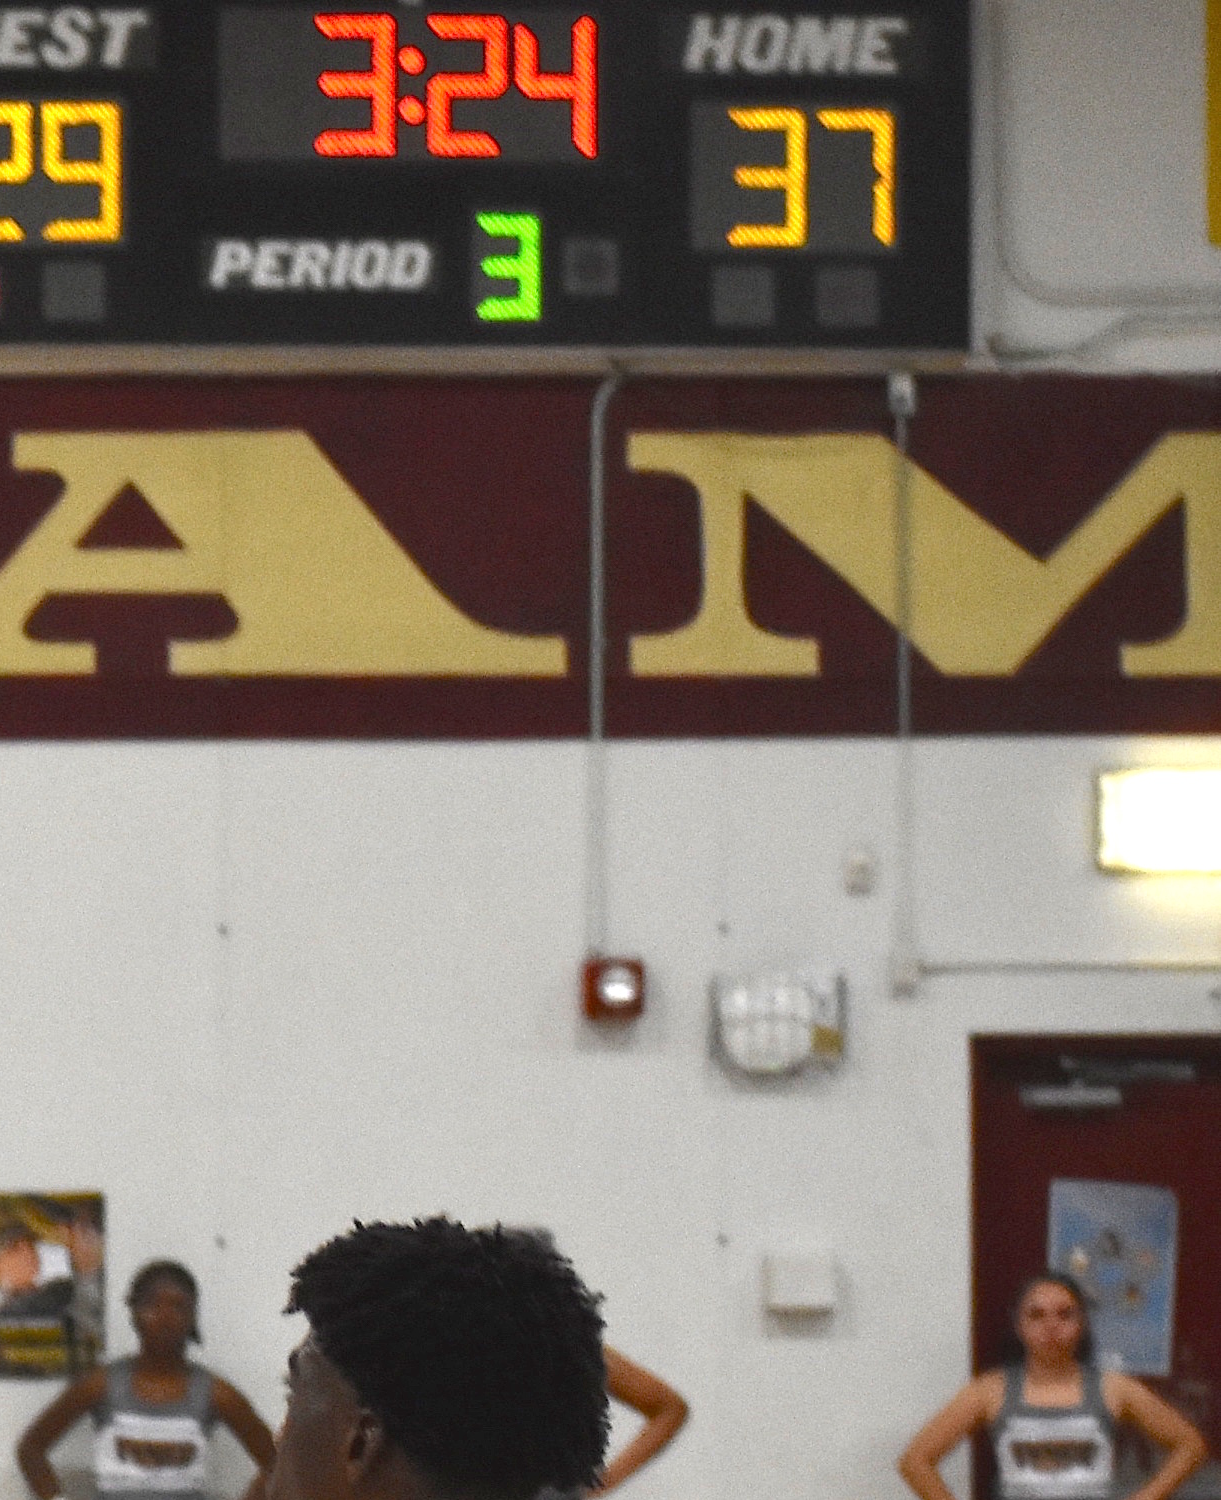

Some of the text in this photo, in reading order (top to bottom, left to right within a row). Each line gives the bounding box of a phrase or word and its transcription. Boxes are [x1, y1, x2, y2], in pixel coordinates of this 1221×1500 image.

[313, 13, 598, 158] 3:24
[683, 14, 910, 74] HOME
[725, 106, 897, 249] 37
[209, 238, 433, 290] PERIOD
[476, 211, 542, 322] 3
